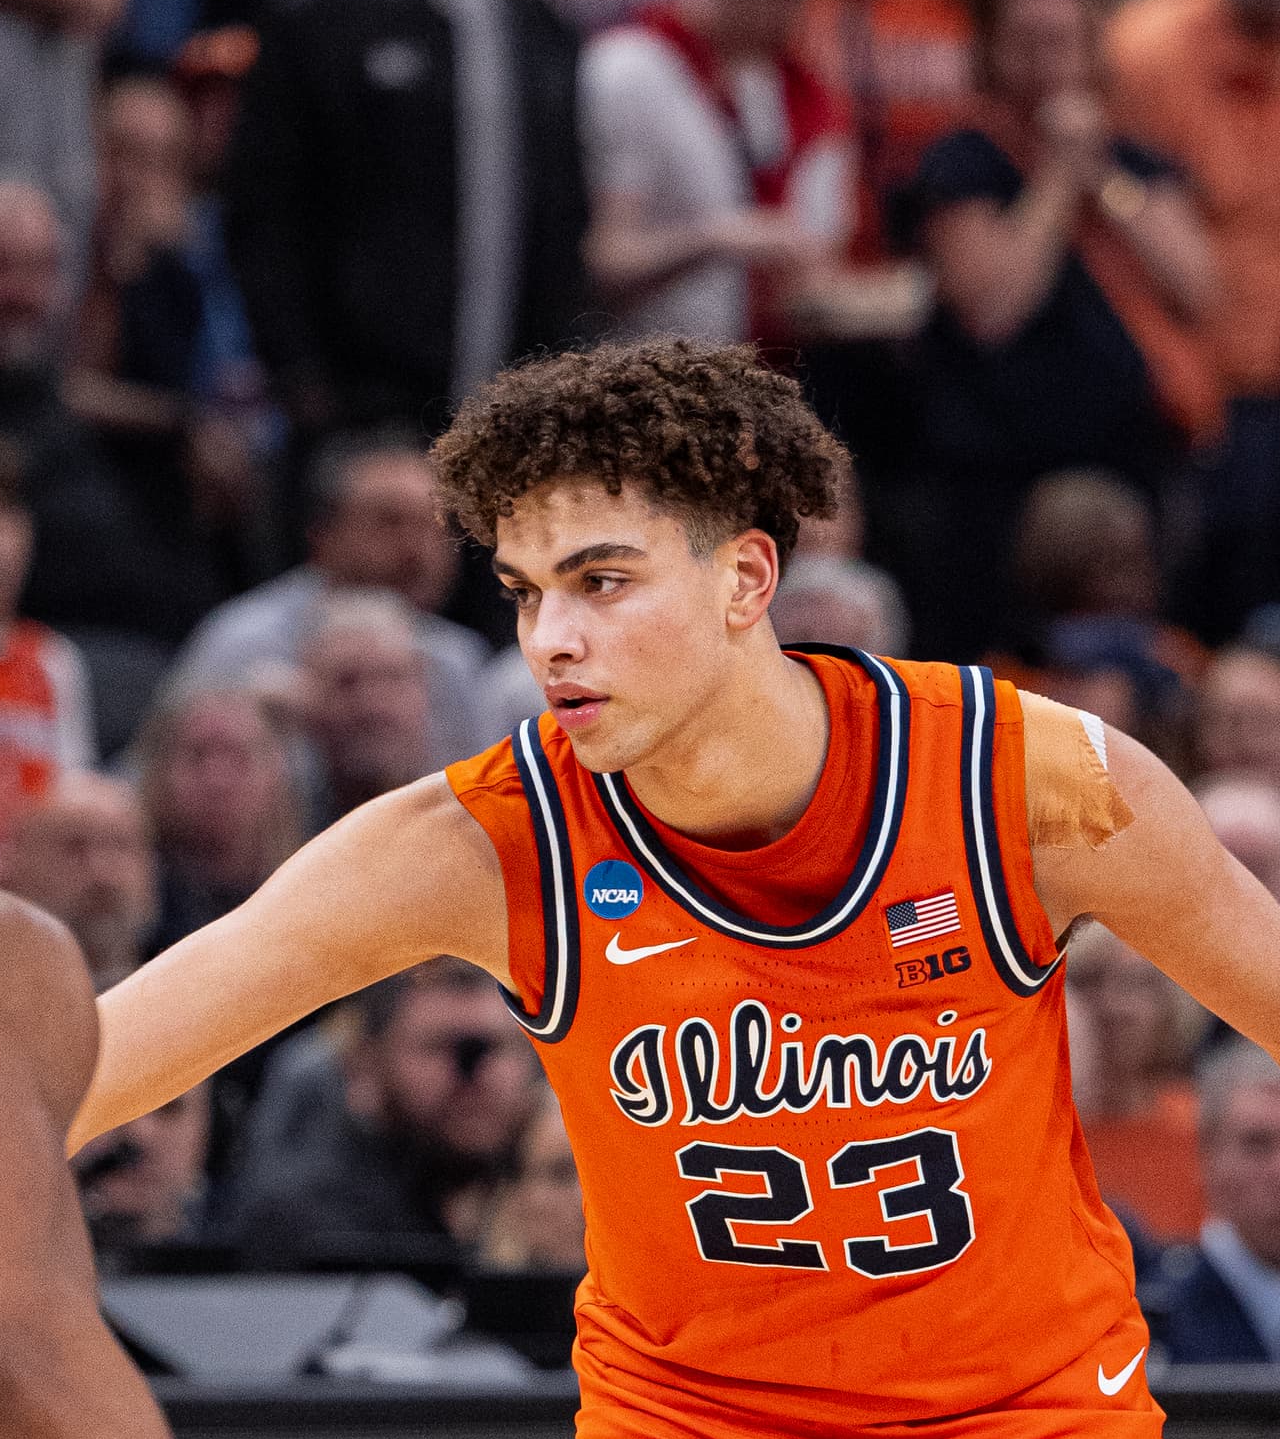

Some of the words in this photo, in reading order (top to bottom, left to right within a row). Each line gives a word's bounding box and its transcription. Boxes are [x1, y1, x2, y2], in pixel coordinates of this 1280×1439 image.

[591, 888, 639, 905] NCAA
[609, 999, 992, 1127] Illinois
[674, 1127, 977, 1280] 23
